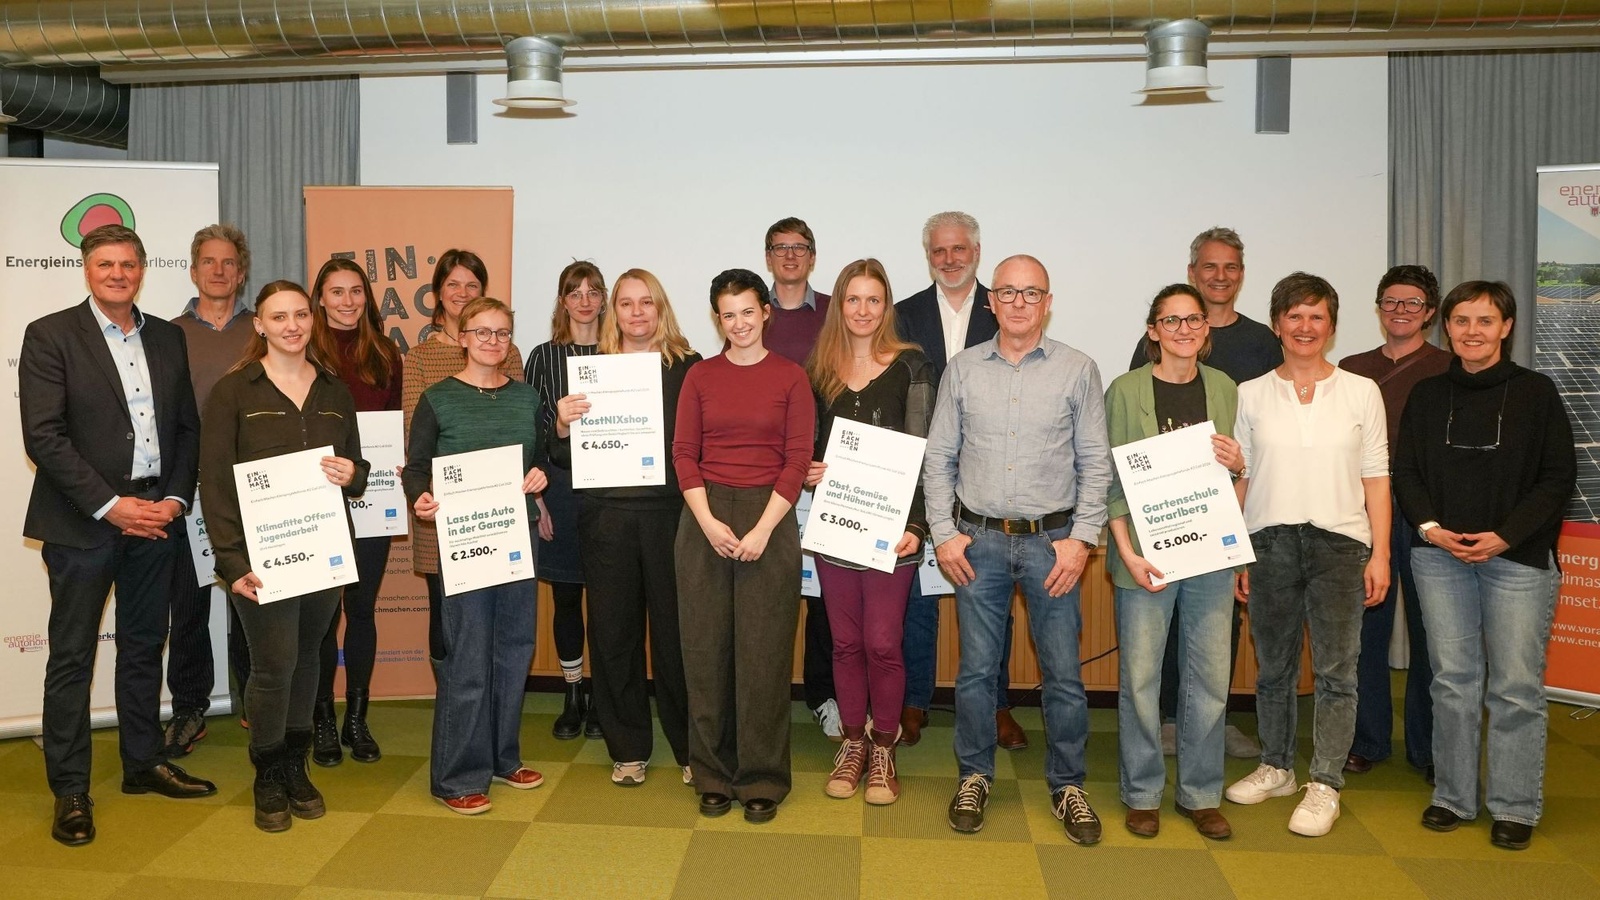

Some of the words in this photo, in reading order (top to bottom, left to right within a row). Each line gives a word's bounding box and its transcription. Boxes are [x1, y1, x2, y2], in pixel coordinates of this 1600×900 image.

[1568, 193, 1600, 206] aut
[6, 256, 83, 270] Energieins
[144, 257, 188, 269] arlberg
[331, 246, 418, 283] IN
[380, 284, 434, 322] AC
[580, 415, 648, 426] KostNIXshop
[581, 441, 589, 450] €
[591, 440, 629, 450] 4.650,-
[1126, 452, 1138, 461] EIN
[1128, 455, 1148, 466] FACH
[1130, 460, 1150, 470] MACH
[444, 468, 462, 476] FACH
[828, 479, 851, 492] Obst,
[853, 486, 888, 502] Gemüse
[826, 490, 842, 500] und
[843, 494, 875, 509] Hühner
[876, 502, 901, 516] teilen
[1142, 487, 1219, 514] Gartenschule
[256, 518, 302, 534] Klimafitte
[304, 511, 336, 523] Offene
[446, 515, 470, 525] Lass
[471, 510, 489, 521] das
[491, 506, 514, 517] Auto
[820, 512, 828, 522] €
[829, 514, 868, 533] 3.000,-
[1145, 503, 1208, 525] Vorarlberg
[258, 525, 319, 544] Jugendarbeit
[448, 527, 457, 536] in
[459, 523, 476, 534] der
[478, 518, 516, 531] Garage
[1153, 541, 1162, 550] €
[1164, 532, 1207, 548] 5.000,-
[262, 559, 272, 569] €
[274, 551, 315, 567] 4.550,-
[450, 552, 458, 561] €
[461, 546, 497, 559] 2.500,-
[1561, 571, 1600, 588] limas
